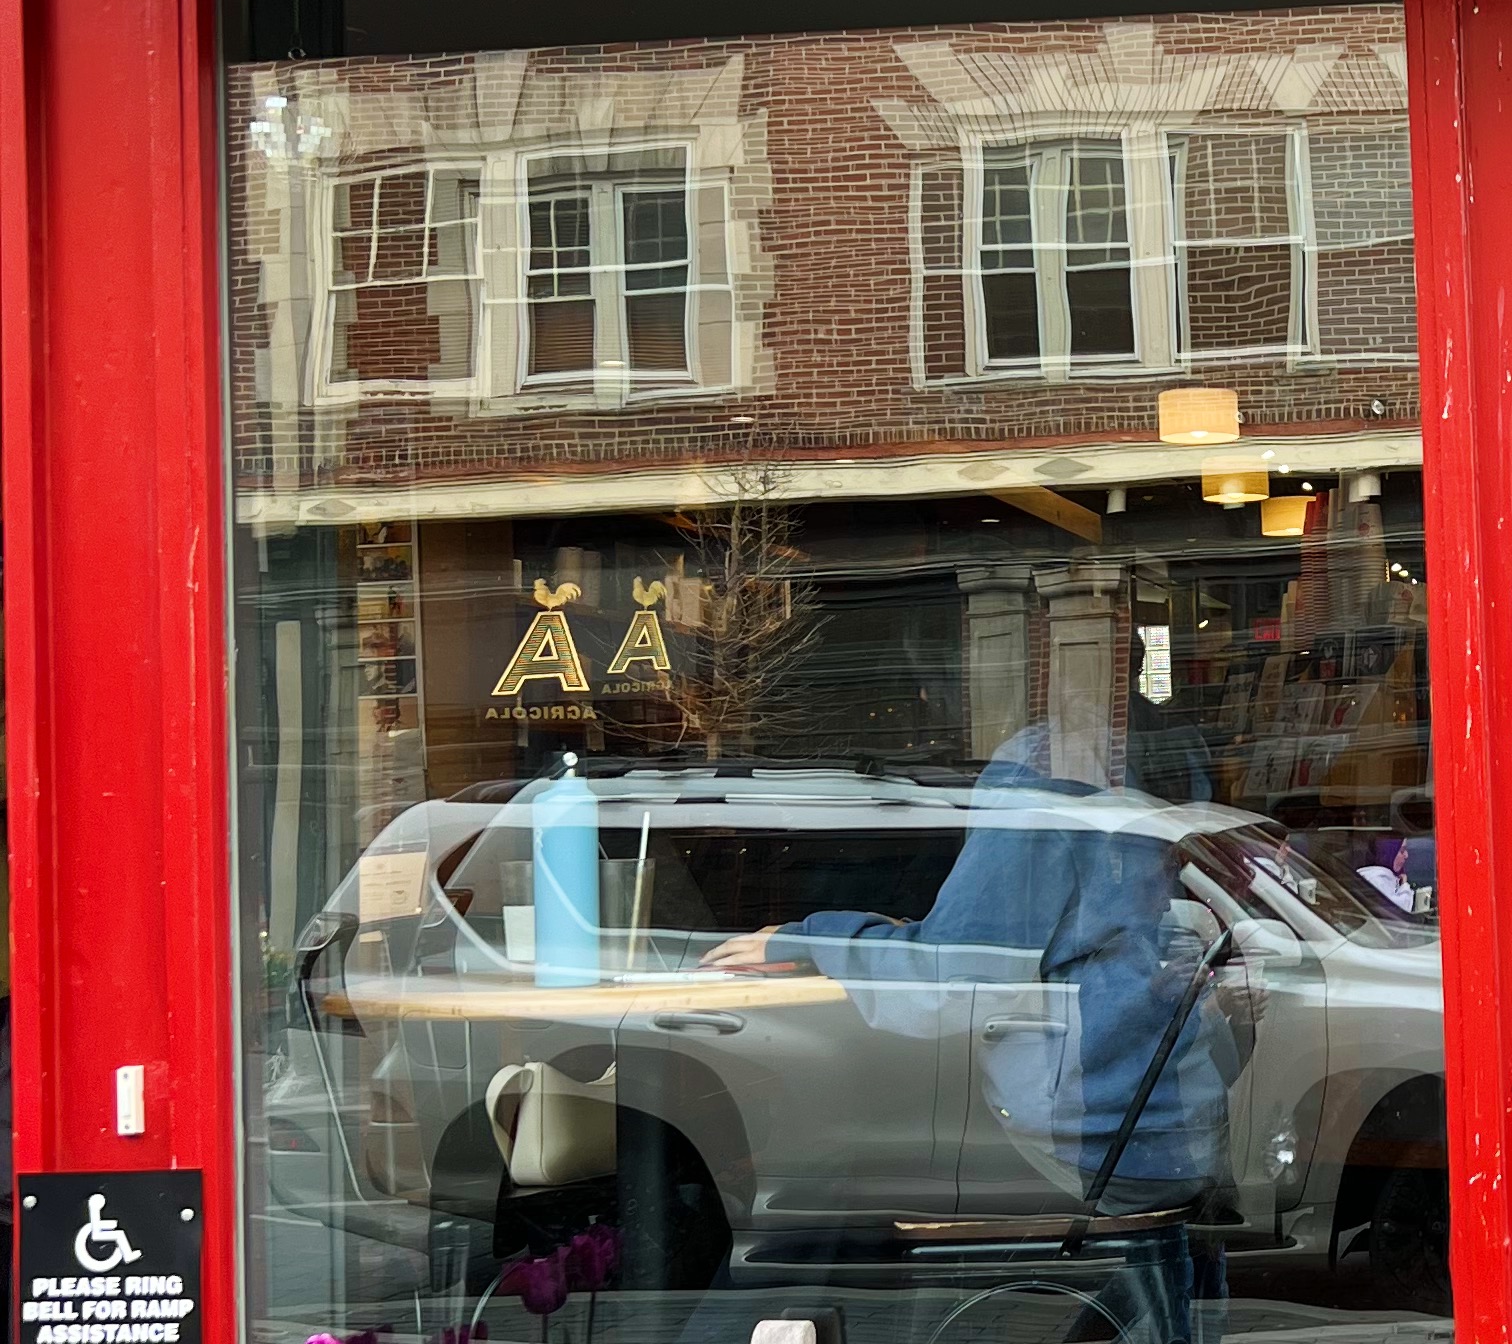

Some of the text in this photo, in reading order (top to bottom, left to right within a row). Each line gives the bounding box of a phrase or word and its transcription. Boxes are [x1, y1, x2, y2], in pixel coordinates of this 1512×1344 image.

[32, 1275, 184, 1298] PLEASE RING
[22, 1299, 195, 1322] BELL FOR RAMP
